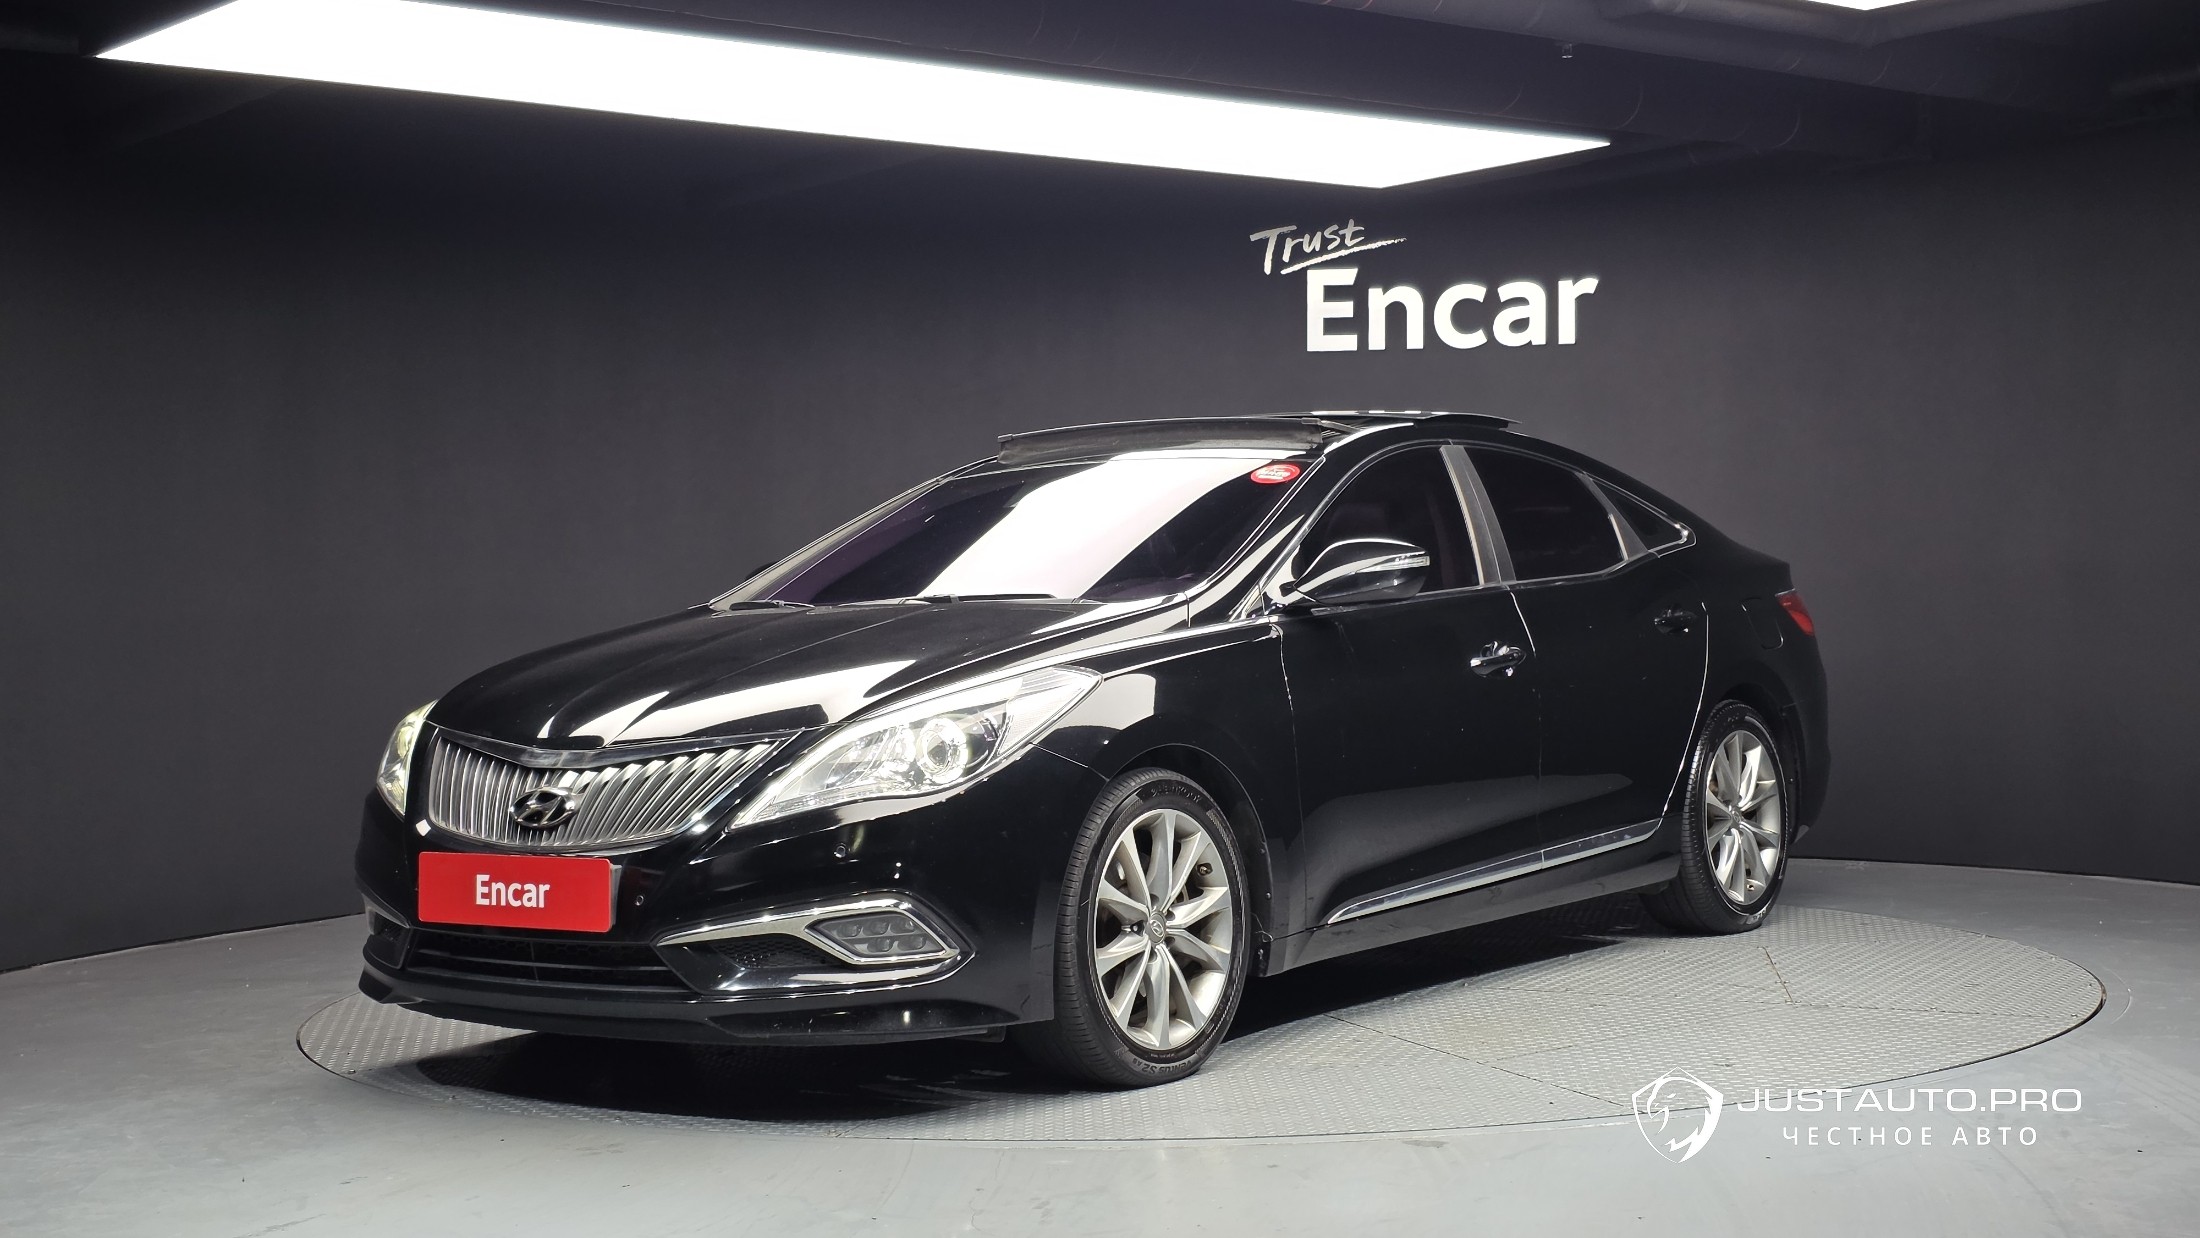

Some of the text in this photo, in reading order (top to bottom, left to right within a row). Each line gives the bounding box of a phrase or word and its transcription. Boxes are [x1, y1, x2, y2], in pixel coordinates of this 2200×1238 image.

[1250, 219, 1365, 275] Trust
[1306, 268, 1599, 352] Encar
[475, 873, 551, 909] Encar
